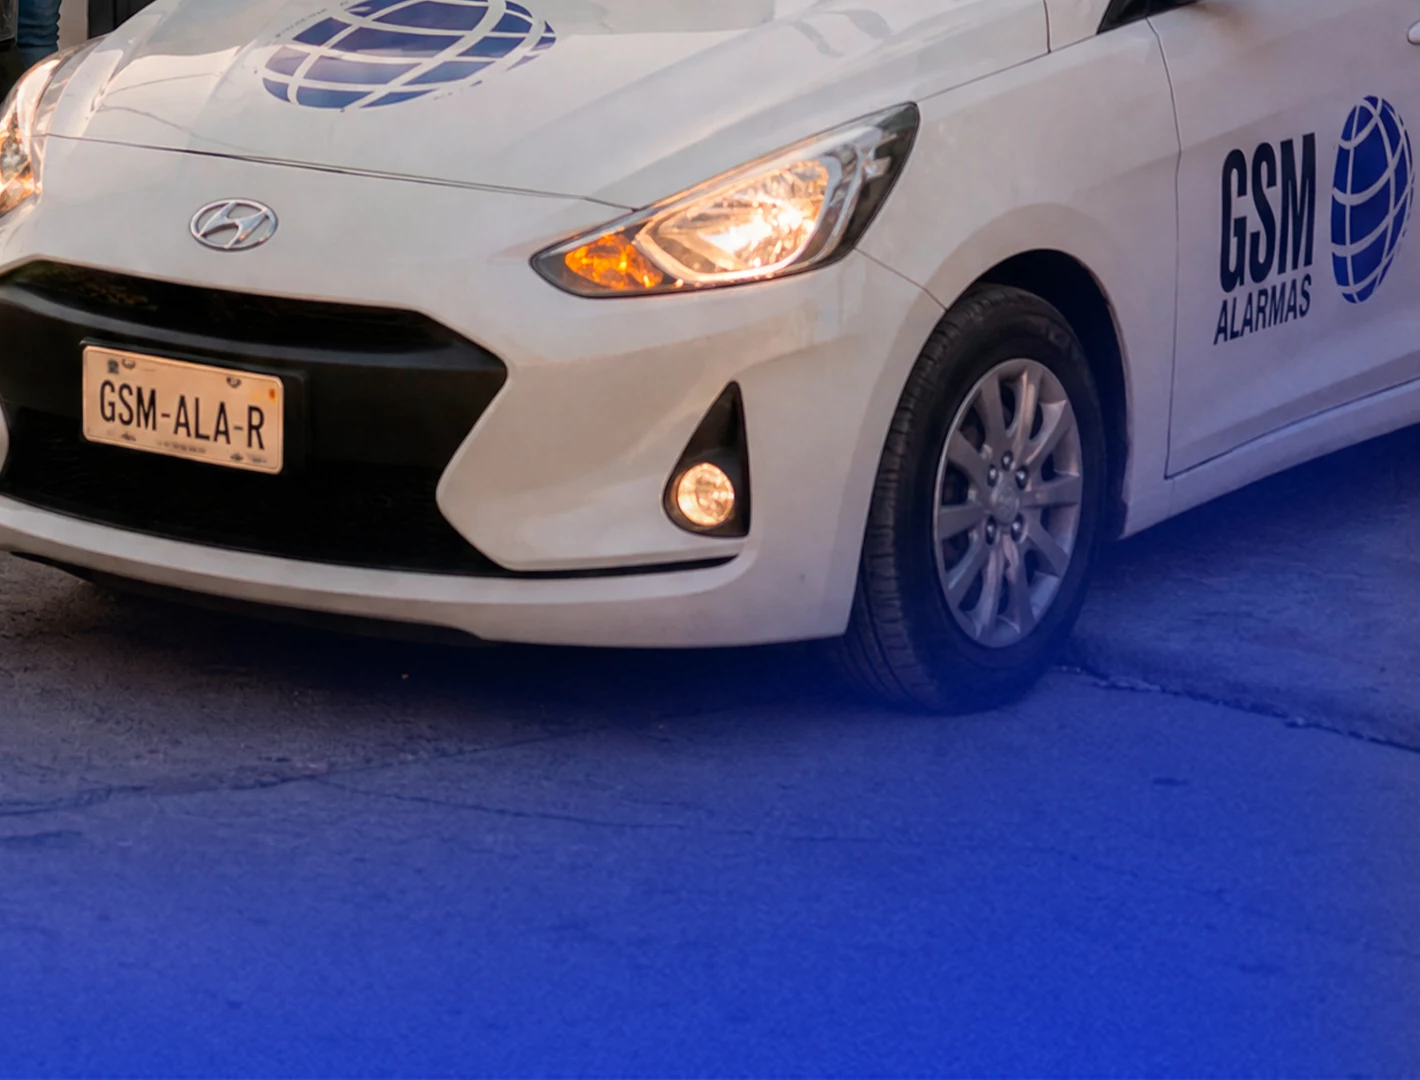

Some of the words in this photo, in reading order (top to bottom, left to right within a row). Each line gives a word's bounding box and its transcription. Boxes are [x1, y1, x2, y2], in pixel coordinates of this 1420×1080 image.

[1219, 132, 1317, 294] GSM
[1212, 273, 1313, 346] ALARMAS
[99, 379, 266, 451] GSM-ALA-R
